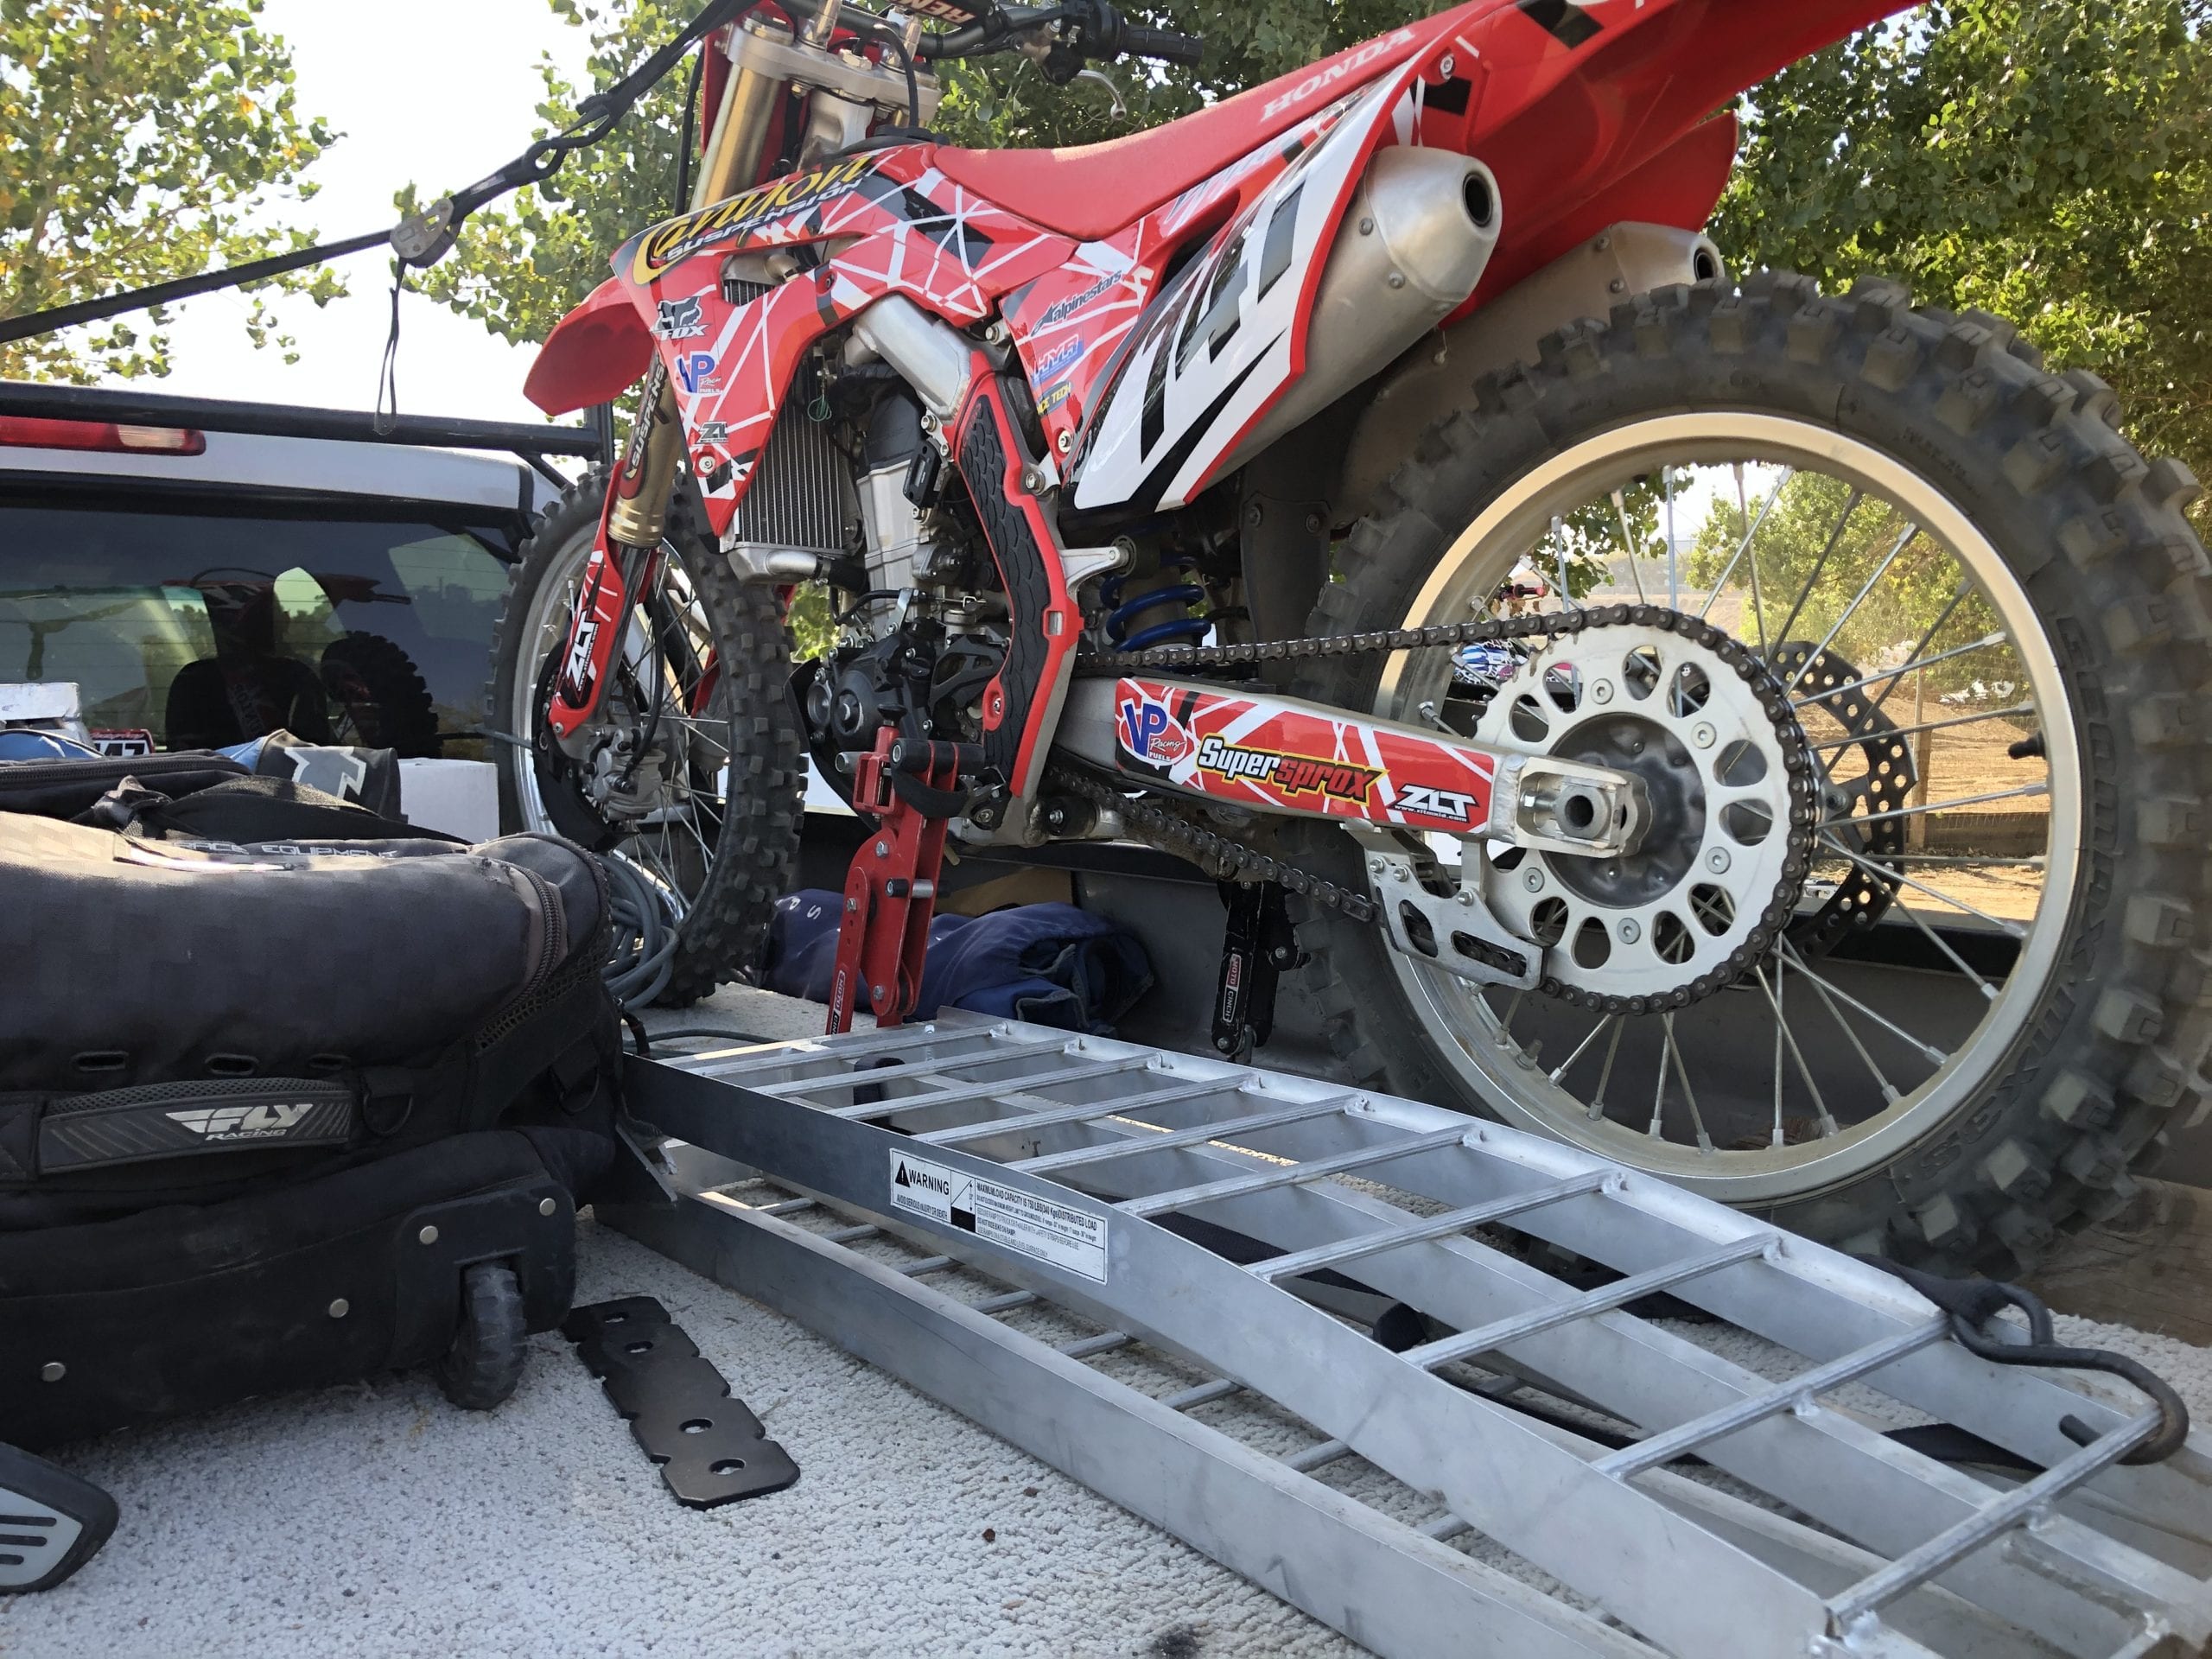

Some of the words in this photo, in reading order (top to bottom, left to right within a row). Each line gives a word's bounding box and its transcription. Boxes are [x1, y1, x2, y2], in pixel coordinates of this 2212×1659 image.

[1260, 29, 1415, 122] HONDA
[665, 177, 862, 260] SUSPENSION
[1052, 270, 1122, 321] alpinestars
[658, 323, 709, 340] FOX
[566, 610, 596, 689] ZLT
[1123, 702, 1168, 758] VP
[1149, 737, 1186, 753] Racing
[1395, 784, 1477, 818] ZLT
[165, 1103, 314, 1134] FLY
[908, 1168, 950, 1196] WARNING
